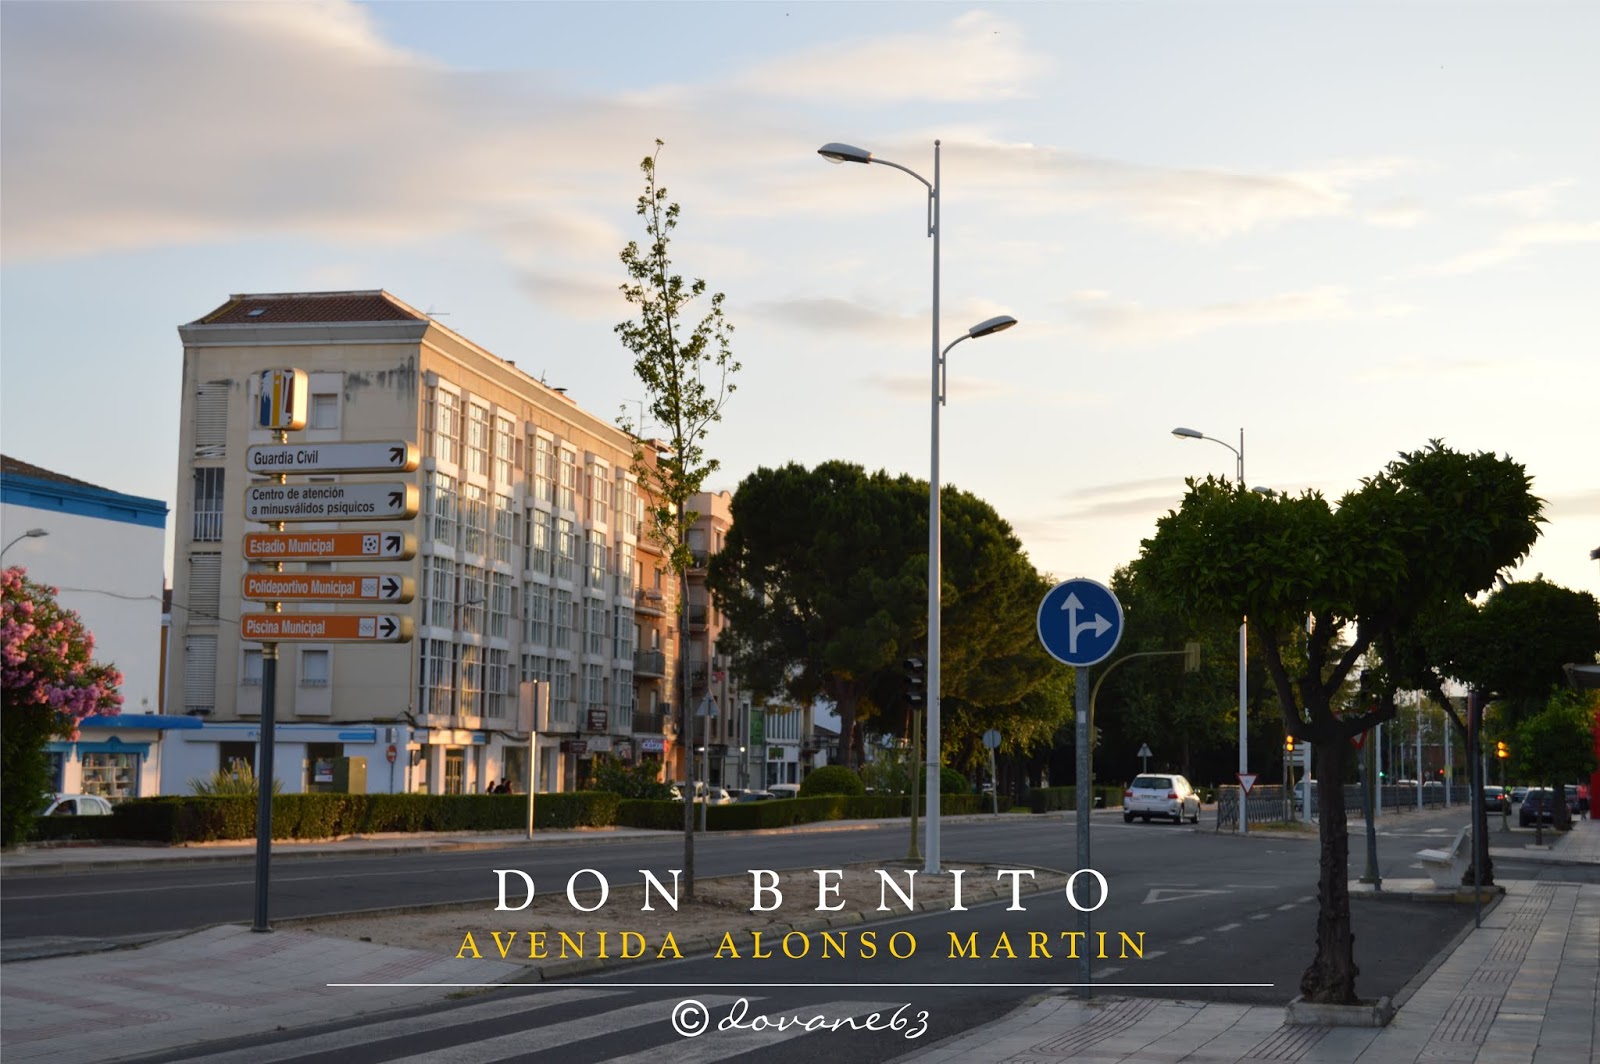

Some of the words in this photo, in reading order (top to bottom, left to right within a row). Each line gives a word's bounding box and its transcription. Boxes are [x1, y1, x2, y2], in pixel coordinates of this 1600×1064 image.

[254, 451, 294, 465] Guardia
[297, 450, 319, 464] Civil
[252, 488, 284, 501] Centro
[287, 487, 300, 500] de
[302, 486, 344, 499] atención
[251, 505, 258, 515] a
[260, 502, 324, 514] minusválidos
[250, 539, 286, 553] Estadio
[288, 538, 335, 555] Municipal
[249, 579, 309, 596] Polideportivo
[311, 579, 355, 597] Municipal
[246, 619, 279, 634] Piscina
[281, 620, 326, 636] Municipal
